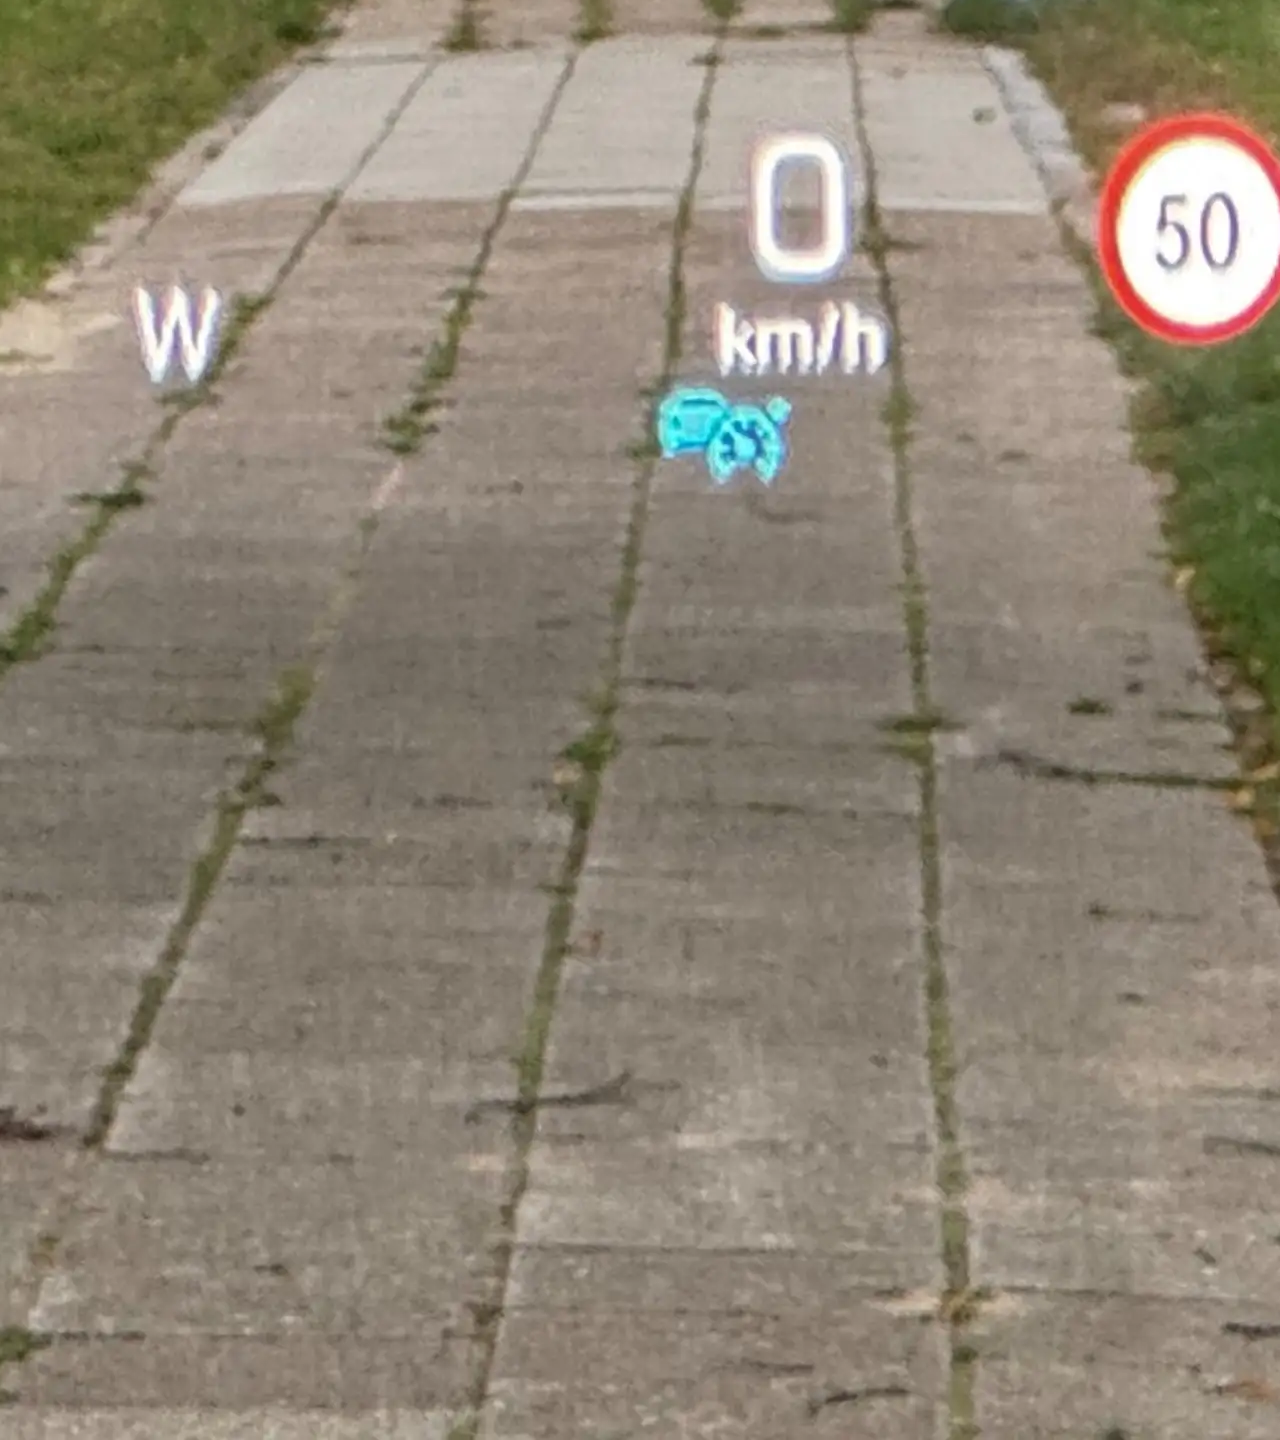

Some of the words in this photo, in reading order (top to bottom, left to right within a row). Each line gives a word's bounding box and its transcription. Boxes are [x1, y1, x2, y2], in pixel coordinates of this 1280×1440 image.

[751, 133, 846, 282] 0
[1155, 191, 1239, 271] 50
[131, 284, 221, 384] W
[714, 300, 888, 377] km/h
